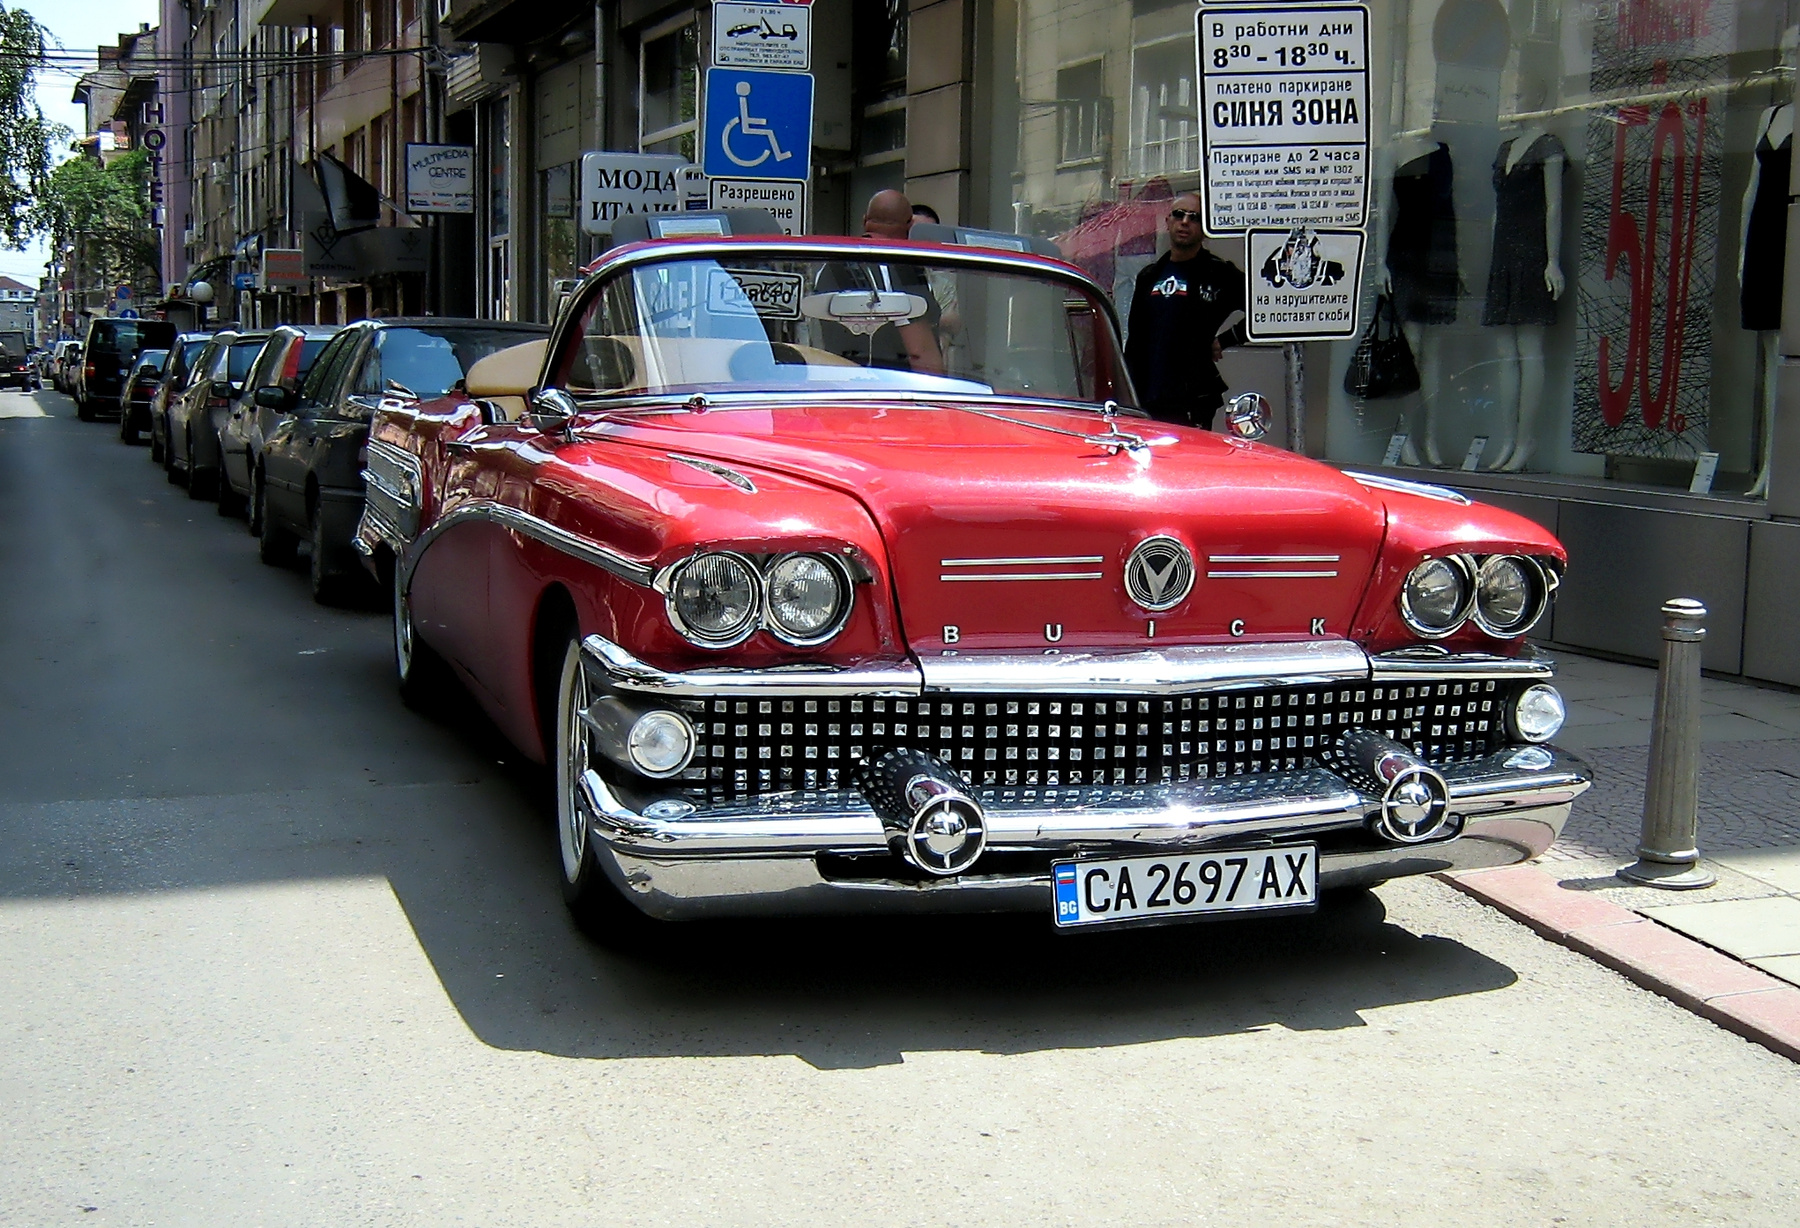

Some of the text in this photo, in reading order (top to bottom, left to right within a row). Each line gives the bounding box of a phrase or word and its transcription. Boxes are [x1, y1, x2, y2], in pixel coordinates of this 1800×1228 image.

[1212, 22, 1354, 41] В работни дни
[1217, 80, 1353, 96] платено паркиране
[1213, 98, 1359, 128] СИНЯ ЗОНА
[143, 102, 166, 229] HOTEL
[412, 149, 470, 172] MULTIMEDIA
[1213, 149, 1361, 166] Паркиране до 2 часа
[428, 167, 467, 179] CENTRE
[1231, 168, 1260, 176] талони
[1283, 166, 1302, 175] SMS
[1305, 167, 1316, 175] на
[1333, 165, 1353, 174] 1302
[598, 168, 677, 194] МОДА
[720, 184, 795, 202] Разрешено
[1256, 293, 1349, 307] на нарушителите
[1254, 308, 1350, 323] се поставят скоби
[1084, 852, 1308, 914] CA 2697 AX
[1059, 901, 1078, 916] BG
